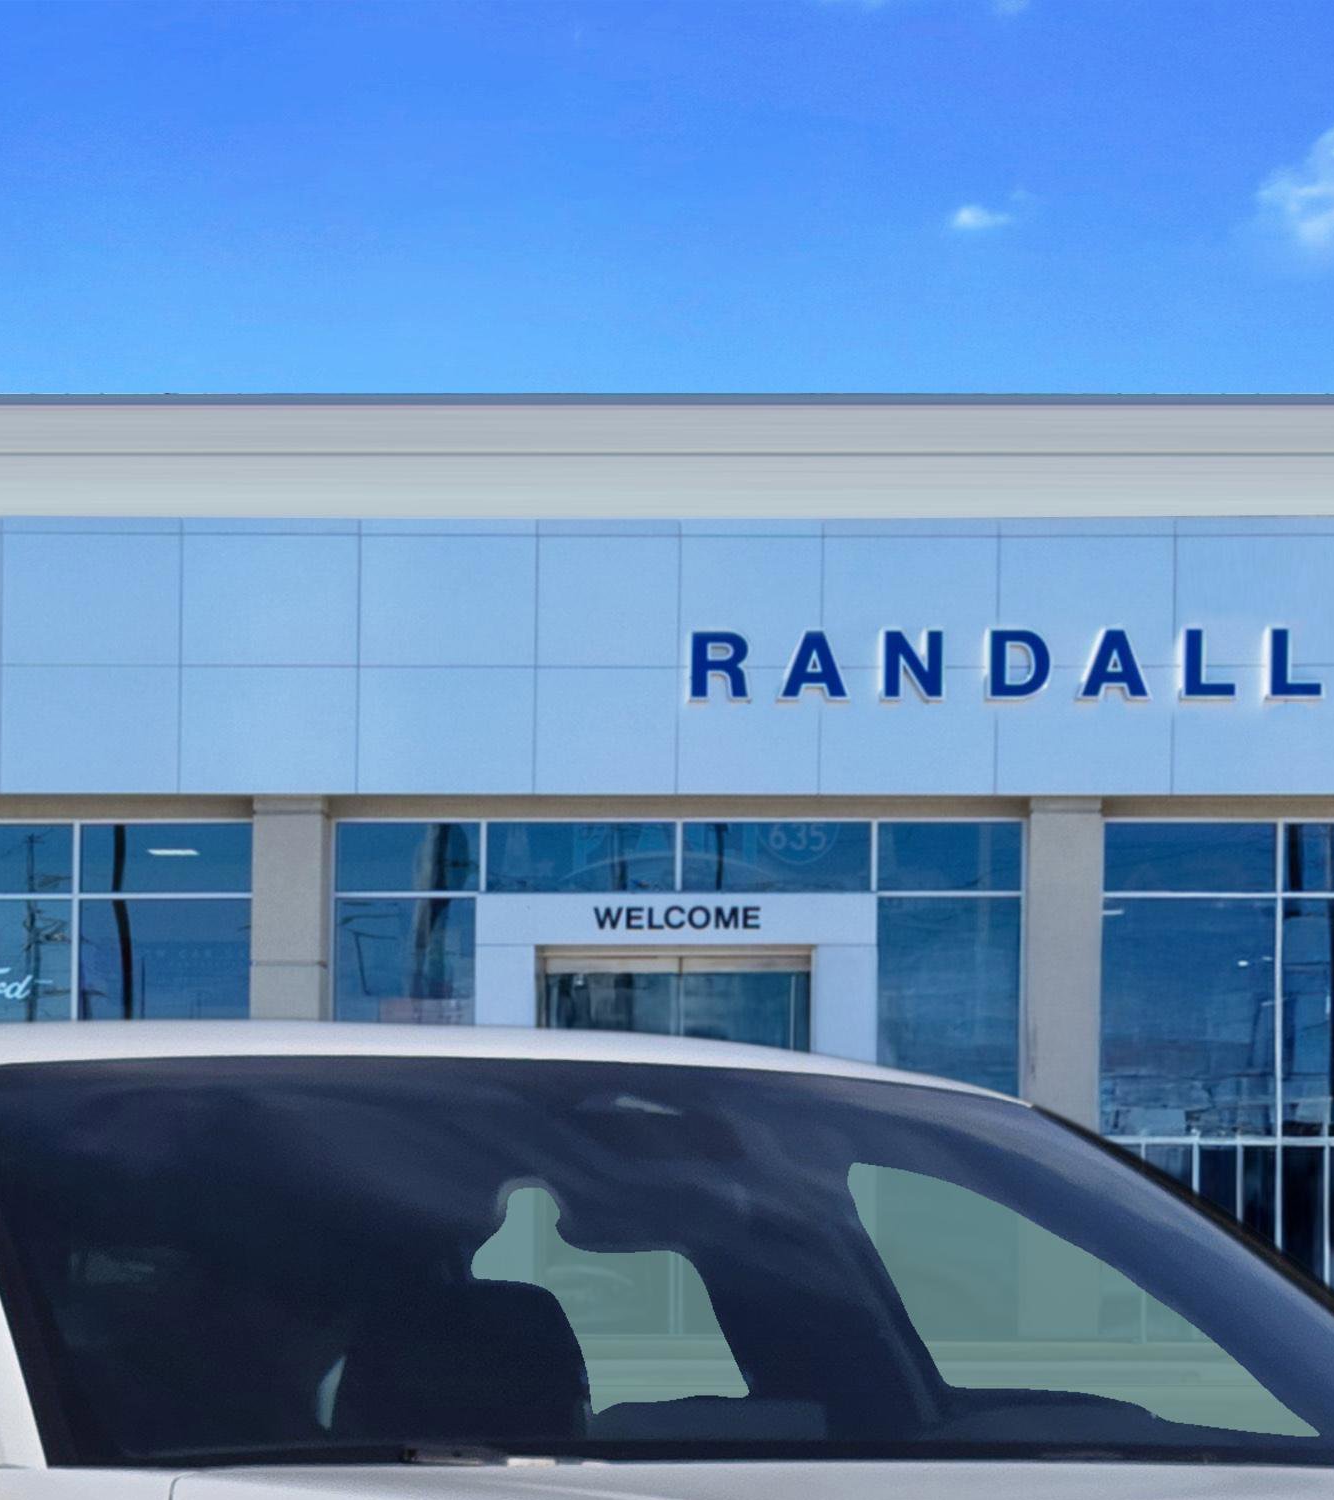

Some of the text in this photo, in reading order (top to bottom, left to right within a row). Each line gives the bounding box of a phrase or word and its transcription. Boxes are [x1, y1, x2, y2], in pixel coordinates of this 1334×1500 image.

[688, 627, 1324, 700] RANDALL
[768, 824, 827, 851] 635
[593, 905, 762, 931] WELCOME
